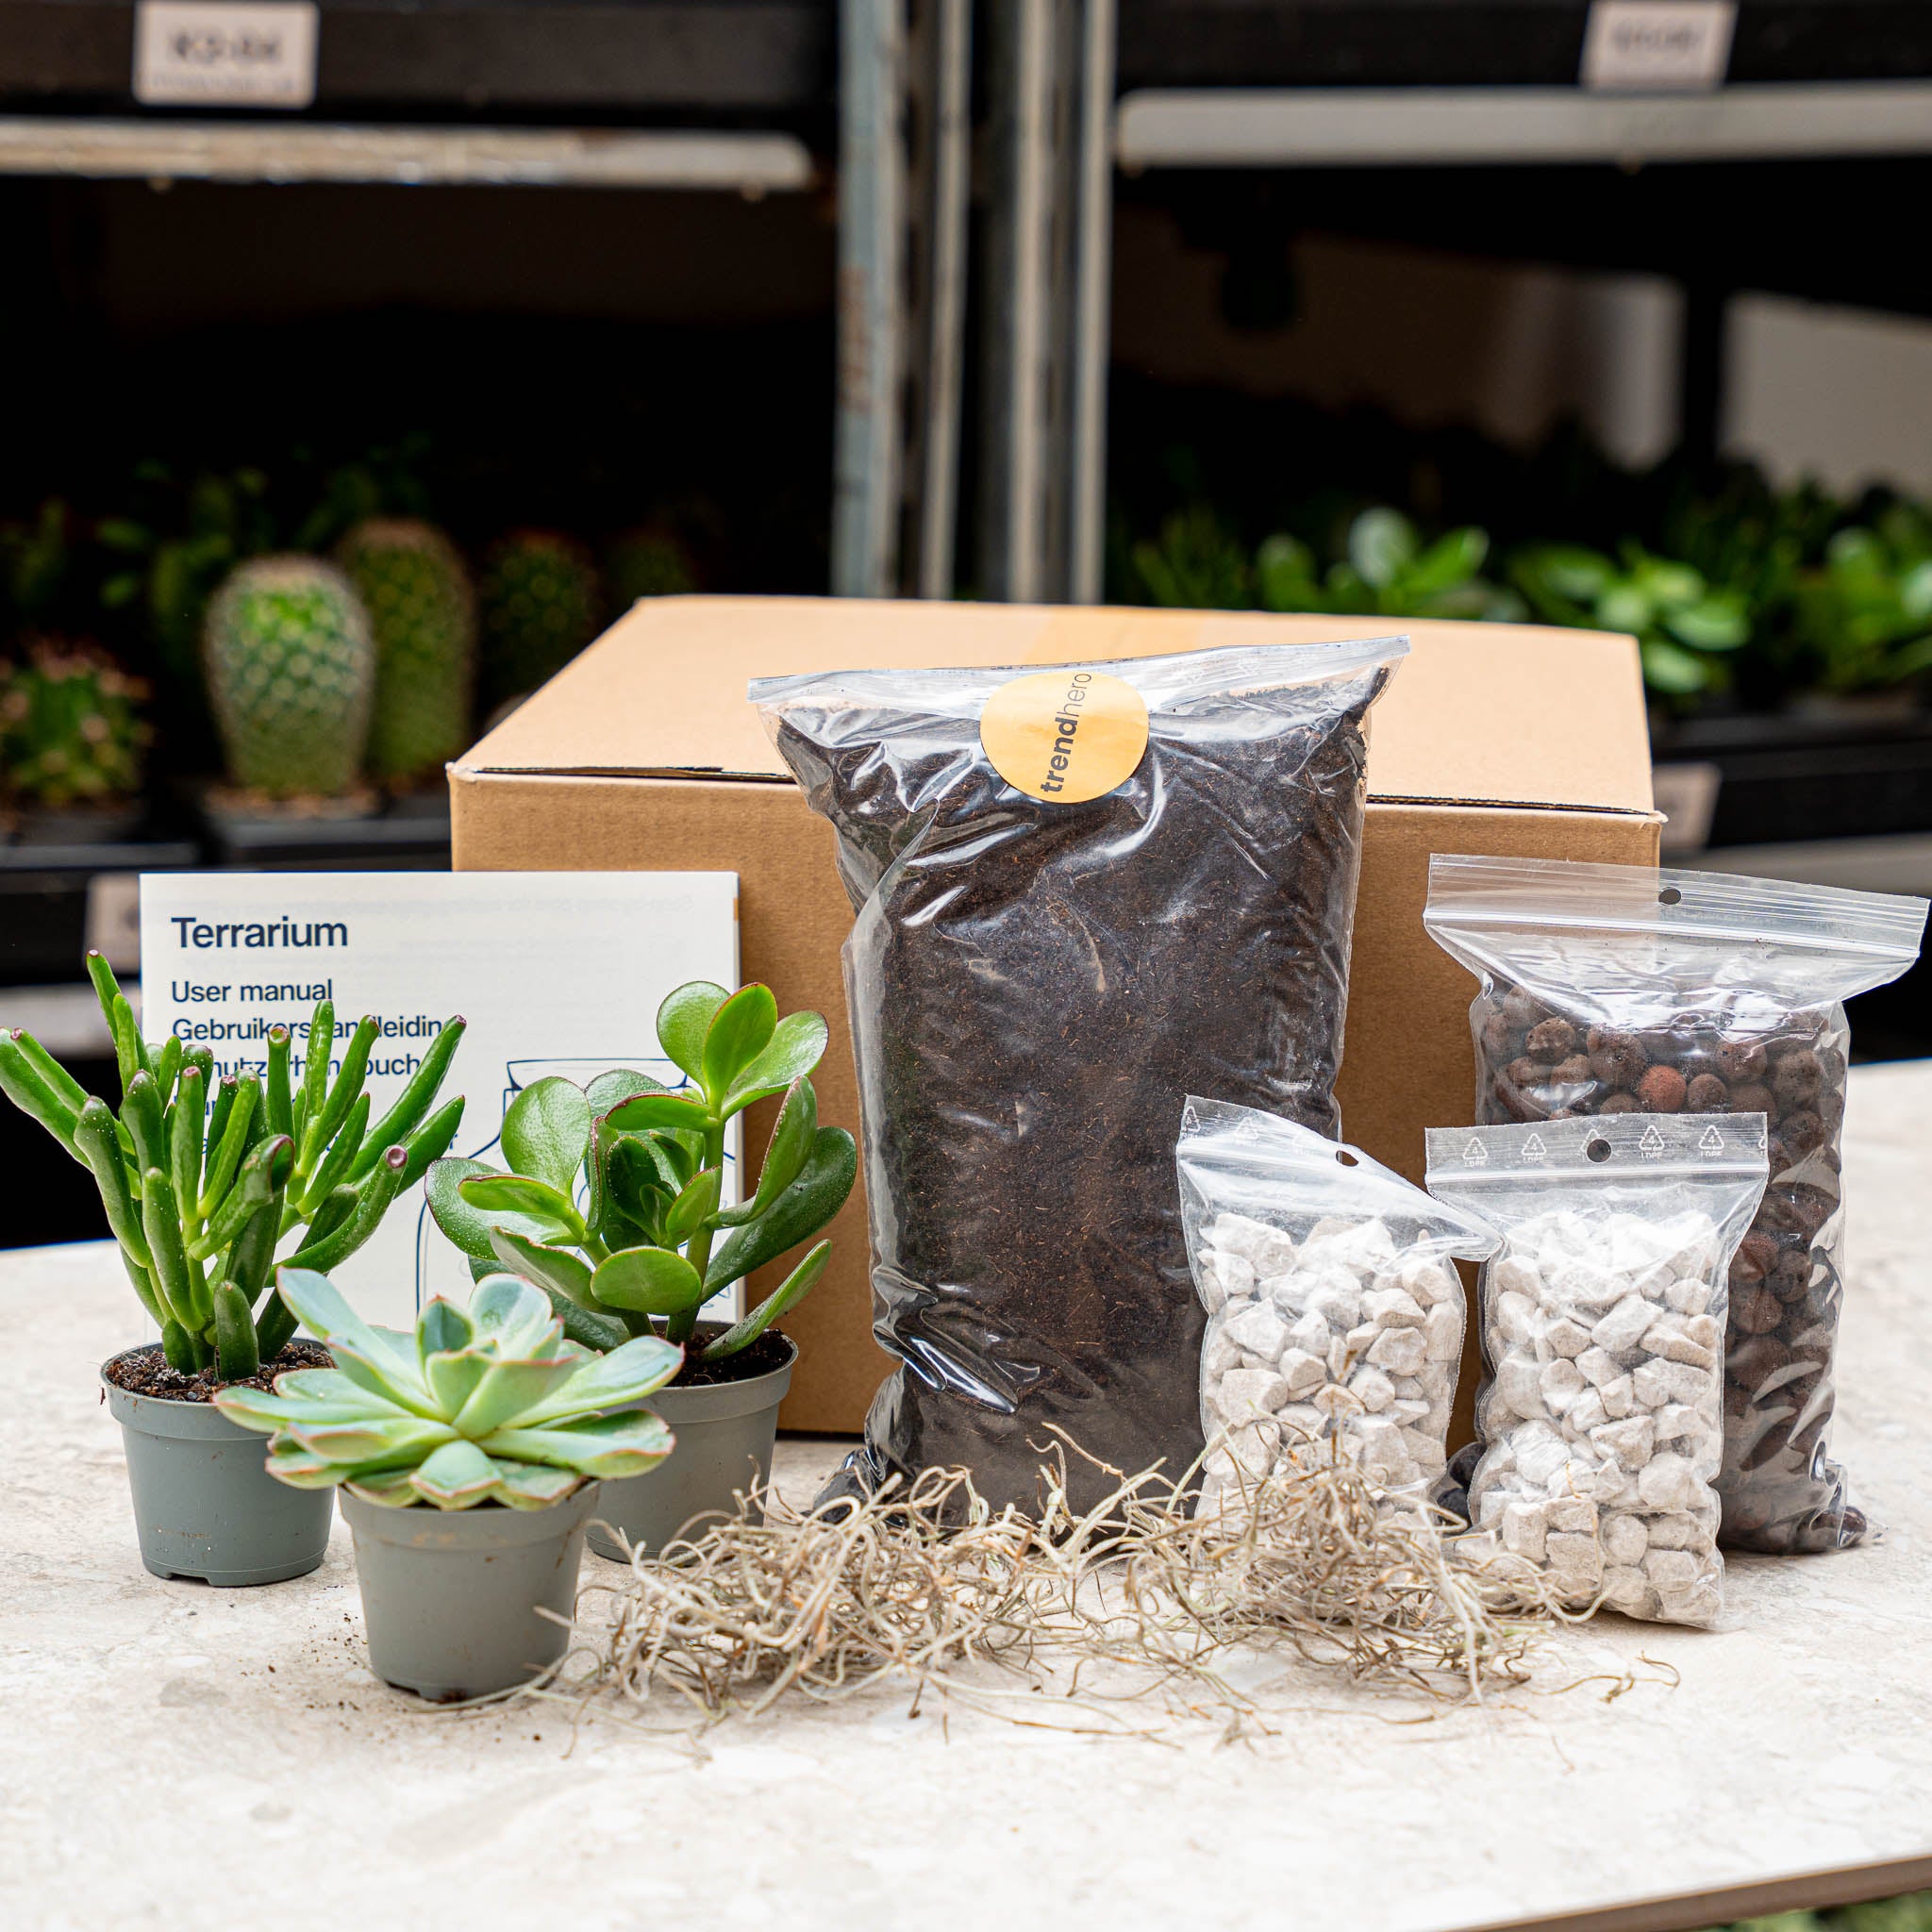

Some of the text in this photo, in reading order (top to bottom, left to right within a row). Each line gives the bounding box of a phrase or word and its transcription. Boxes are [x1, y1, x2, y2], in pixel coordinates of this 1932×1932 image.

[1041, 673, 1092, 793] trendhero
[171, 916, 348, 948] Terrarium
[172, 978, 332, 1003] User manual
